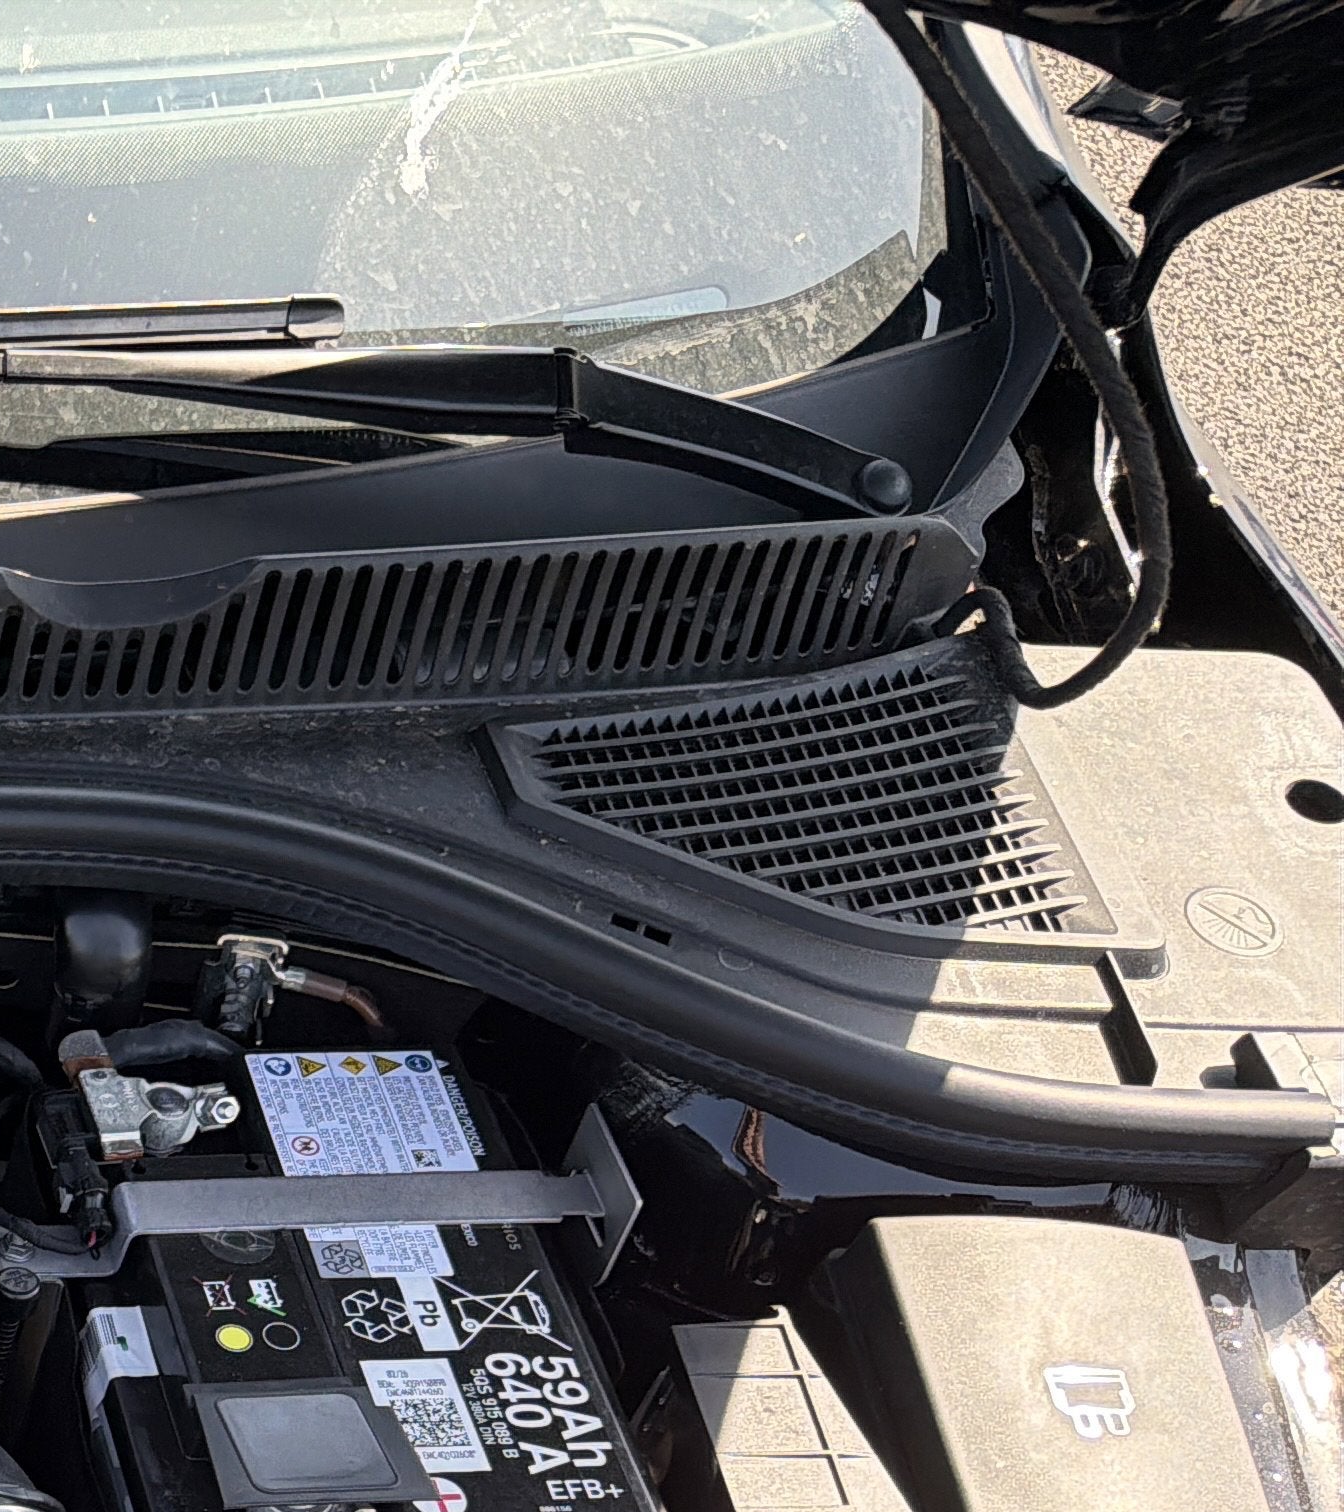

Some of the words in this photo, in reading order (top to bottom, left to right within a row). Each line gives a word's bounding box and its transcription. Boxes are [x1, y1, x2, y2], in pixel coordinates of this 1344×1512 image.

[441, 1075, 485, 1155] DANGER/POISON
[413, 1300, 441, 1327] Pb
[484, 1352, 553, 1428] 640
[462, 1383, 478, 1399] 12V
[479, 1427, 497, 1445] DIN
[482, 1398, 503, 1419] 915
[532, 1355, 612, 1467] 59Ah
[491, 1421, 514, 1445] 089
[502, 1449, 520, 1458] B
[518, 1441, 571, 1475] A
[546, 1479, 624, 1500] EFB+
